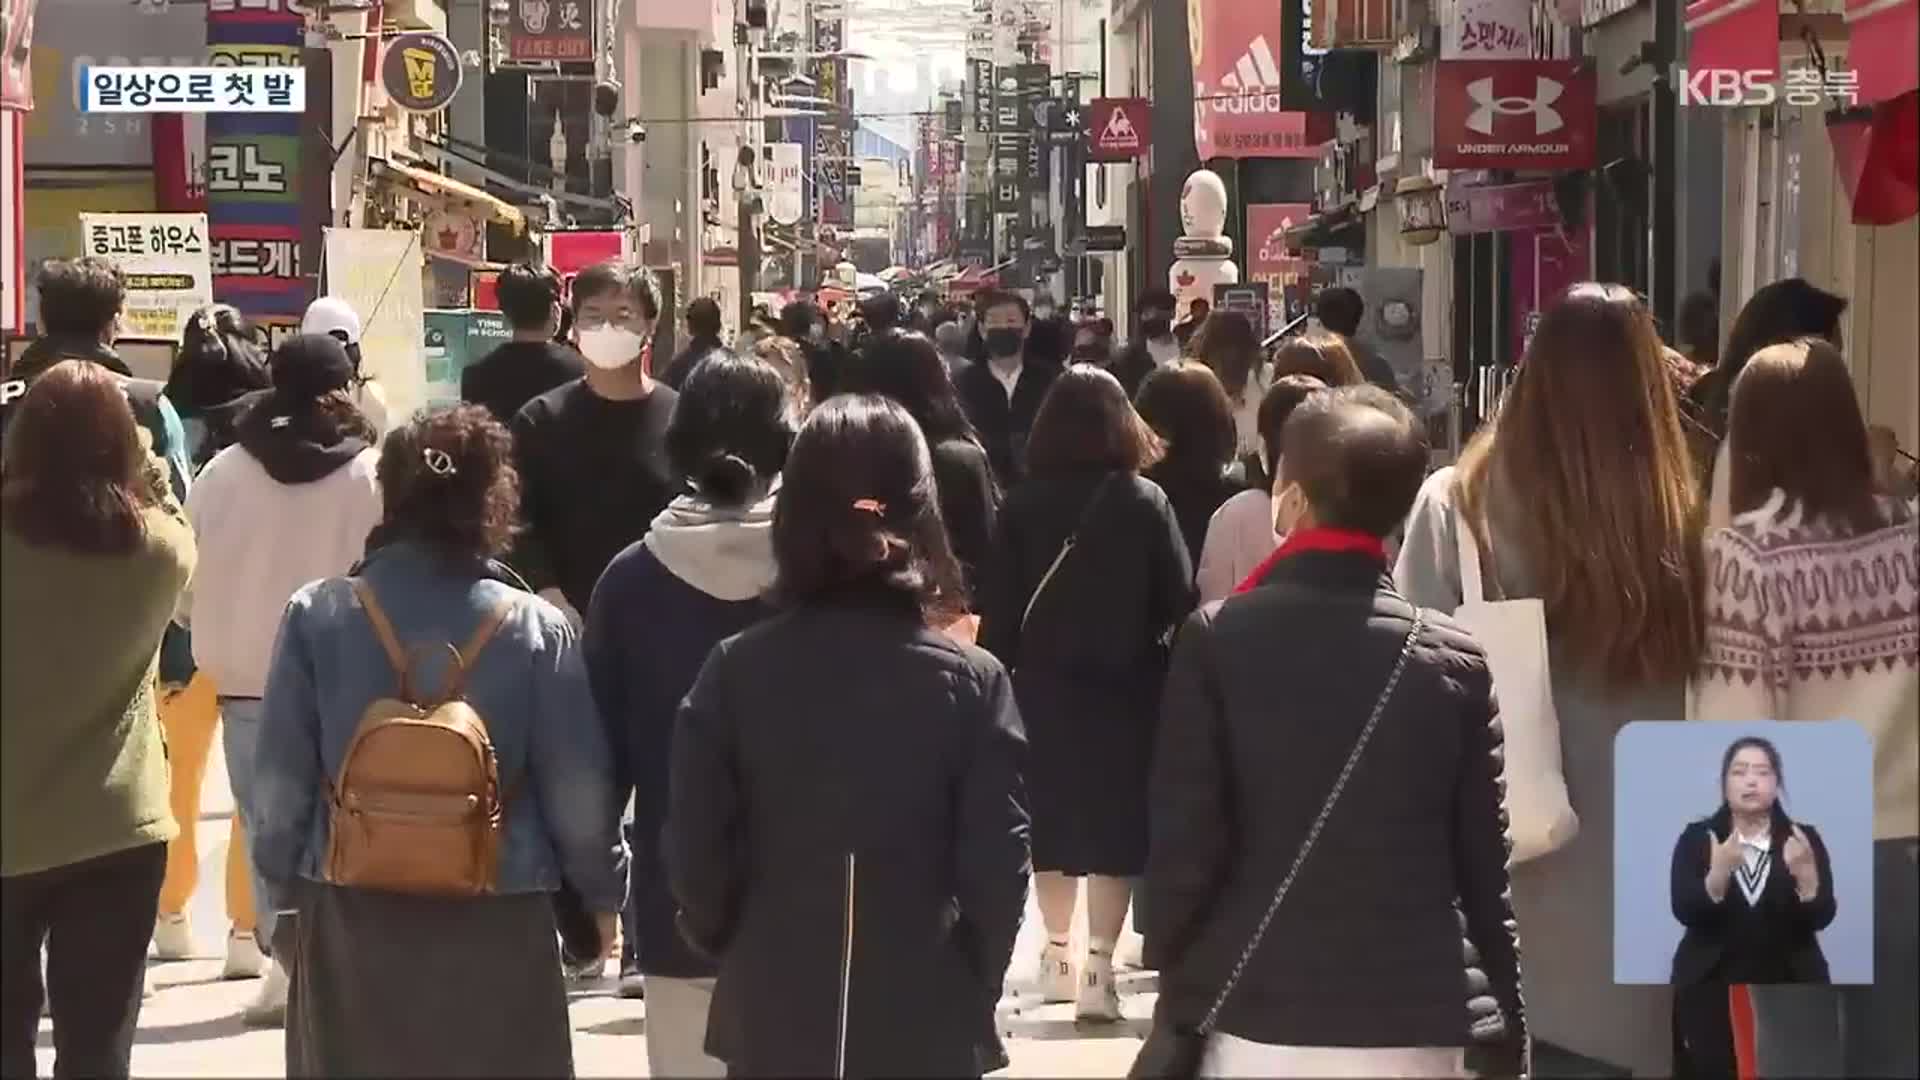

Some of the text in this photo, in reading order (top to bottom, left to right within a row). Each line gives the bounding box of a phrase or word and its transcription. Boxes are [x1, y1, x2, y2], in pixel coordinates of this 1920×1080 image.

[516, 39, 586, 57] TAKE OUT
[1213, 88, 1280, 113] adida
[1457, 143, 1569, 154] UNDER ARMOUR
[208, 144, 286, 192] 코노
[92, 225, 202, 256] 중고폰 하우스
[208, 238, 301, 279] 보드게
[481, 328, 514, 339] SCHOO
